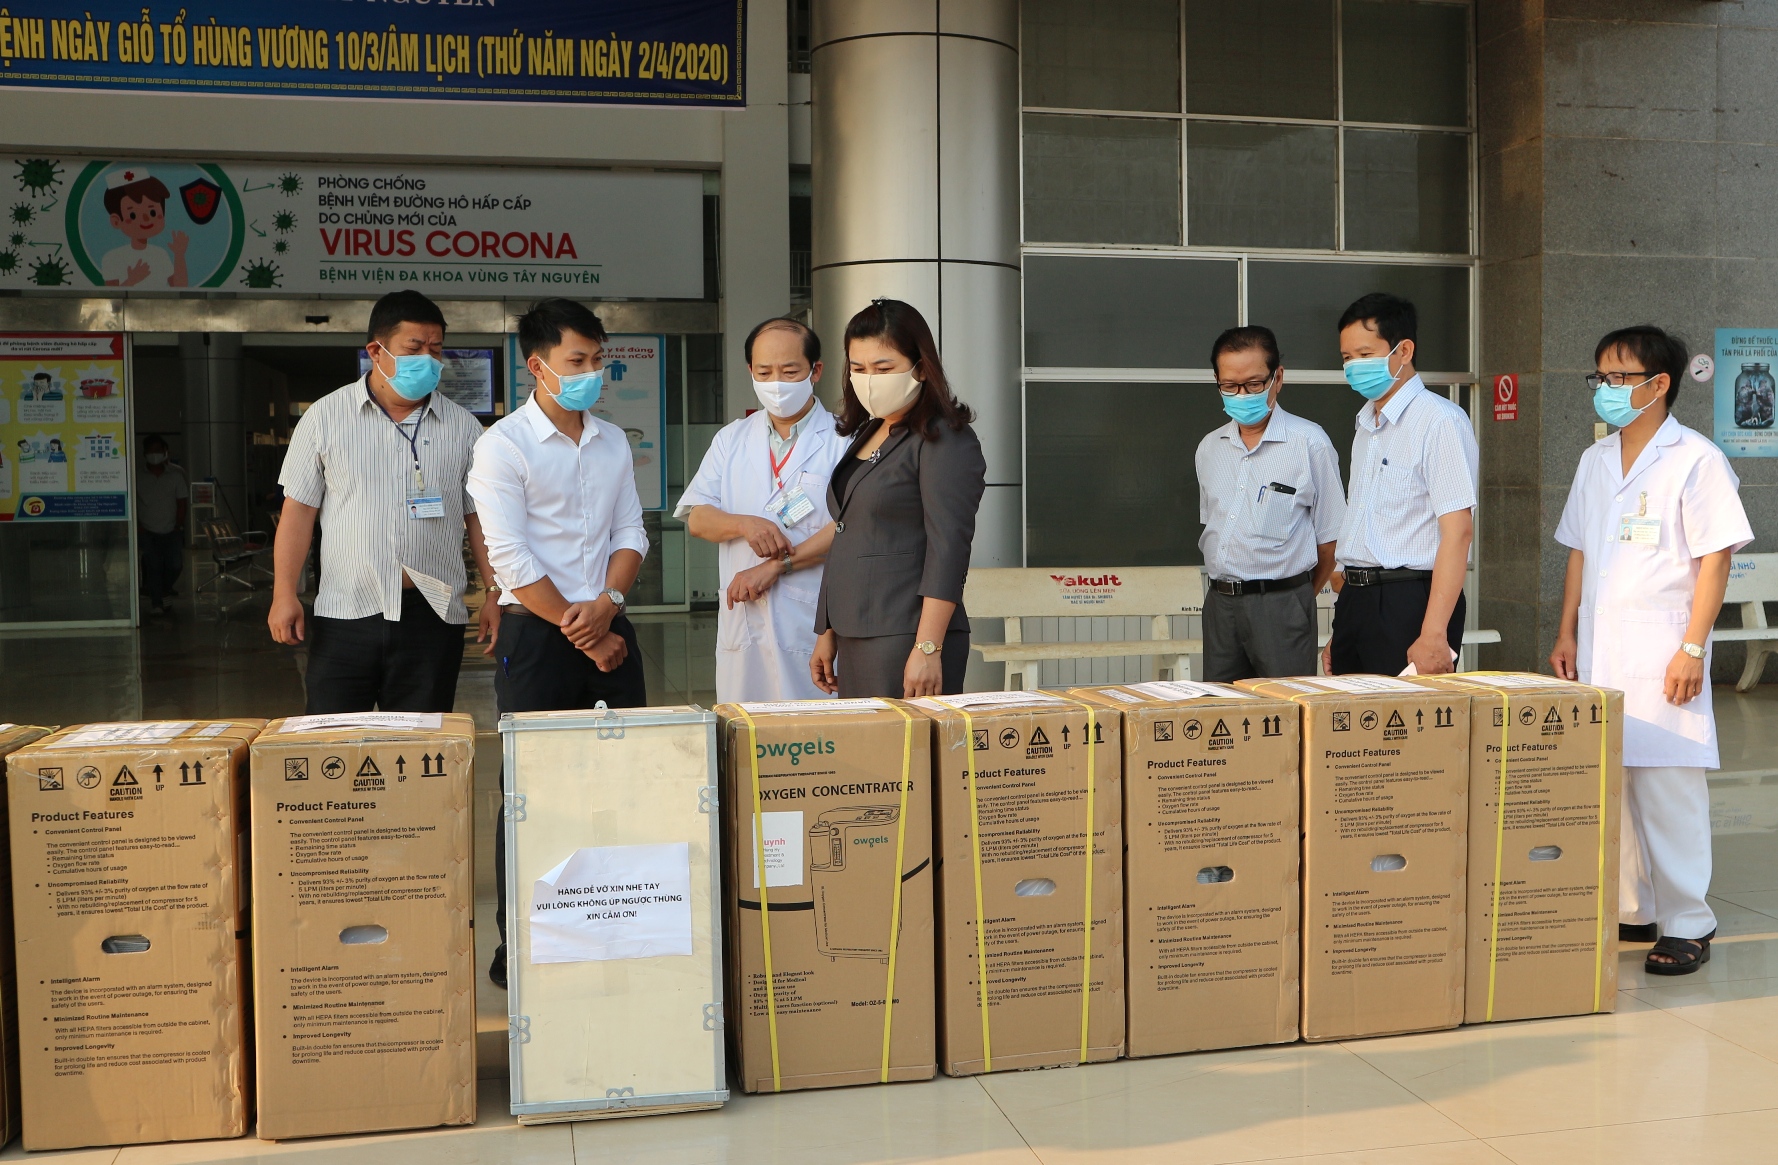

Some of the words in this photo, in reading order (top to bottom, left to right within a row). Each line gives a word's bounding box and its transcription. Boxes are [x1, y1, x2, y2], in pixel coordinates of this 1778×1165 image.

[0, 8, 45, 67] ỆNH
[51, 12, 110, 62] NGÀY
[118, 8, 154, 63] GIỖ
[160, 8, 186, 65] TỔ
[193, 17, 251, 67] HÙNG
[257, 25, 328, 69] VƯƠNG
[335, 24, 419, 72] 10/3/ÂM
[425, 34, 470, 81] LỊCH
[477, 29, 523, 78] (THỨ
[528, 30, 573, 76] NĂM
[580, 32, 632, 77] NGÀY
[638, 41, 728, 85] 2/4/2020)
[318, 174, 369, 189] PHÒNG
[373, 174, 426, 190] CHỐNG
[318, 192, 354, 209] BỆNH
[358, 193, 390, 207] VIÊM
[393, 194, 444, 208] ĐƯỜNG
[448, 194, 469, 209] HÔ
[472, 194, 499, 210] HẤP
[503, 194, 532, 210] CẤP
[319, 213, 340, 224] DO
[344, 210, 394, 225] CHỦNG
[398, 212, 424, 226] MỚI
[428, 212, 457, 226] CỦA
[319, 228, 416, 257] VIRUS
[425, 230, 578, 259] CORONA
[319, 267, 357, 283] BỆNH
[361, 267, 394, 284] VIỆN
[399, 270, 419, 281] ĐA
[423, 270, 464, 282] KHOA
[468, 269, 508, 283] VÙNG
[513, 269, 537, 283] TÂY
[541, 270, 600, 284] NGUYÊN
[627, 346, 654, 354] đúng
[1050, 574, 1122, 587] Yakult
[1208, 738, 1234, 746] CAUTION
[1486, 744, 1519, 752] Prouct
[1522, 743, 1557, 751] Features
[757, 737, 835, 765] owgels
[1026, 746, 1053, 754] CAUTION
[1325, 749, 1360, 758] Product
[1362, 748, 1400, 756] Features
[1147, 759, 1184, 769] Product
[1186, 758, 1226, 767] Features
[962, 769, 1001, 779] Poduct
[1004, 767, 1046, 777] Features
[155, 784, 165, 792] UP
[353, 778, 385, 787] CAUTION
[110, 787, 142, 797] CAUTION
[758, 788, 806, 801] OXYGEN
[812, 780, 914, 797] CONCENTRATOR
[276, 802, 323, 812] Product
[326, 800, 376, 810] Features
[31, 812, 79, 822] Product
[82, 810, 134, 820] Features
[764, 838, 786, 847] uynh
[853, 835, 889, 848] owgels
[290, 869, 339, 877] Uncompromised
[557, 886, 582, 896] HÀNG
[610, 885, 624, 893] XIN
[625, 884, 643, 893] NHẸ
[536, 902, 551, 911] VUI
[552, 900, 576, 909] LÒNG
[577, 898, 607, 907] KHÔNG
[609, 897, 620, 906] ÚP
[622, 895, 652, 905] NGƯỢC
[653, 894, 682, 903] THÙNG
[586, 912, 600, 920] XIN
[602, 910, 620, 919] CẢM
[622, 910, 637, 918] ƠN!
[292, 1032, 321, 1040] Improved
